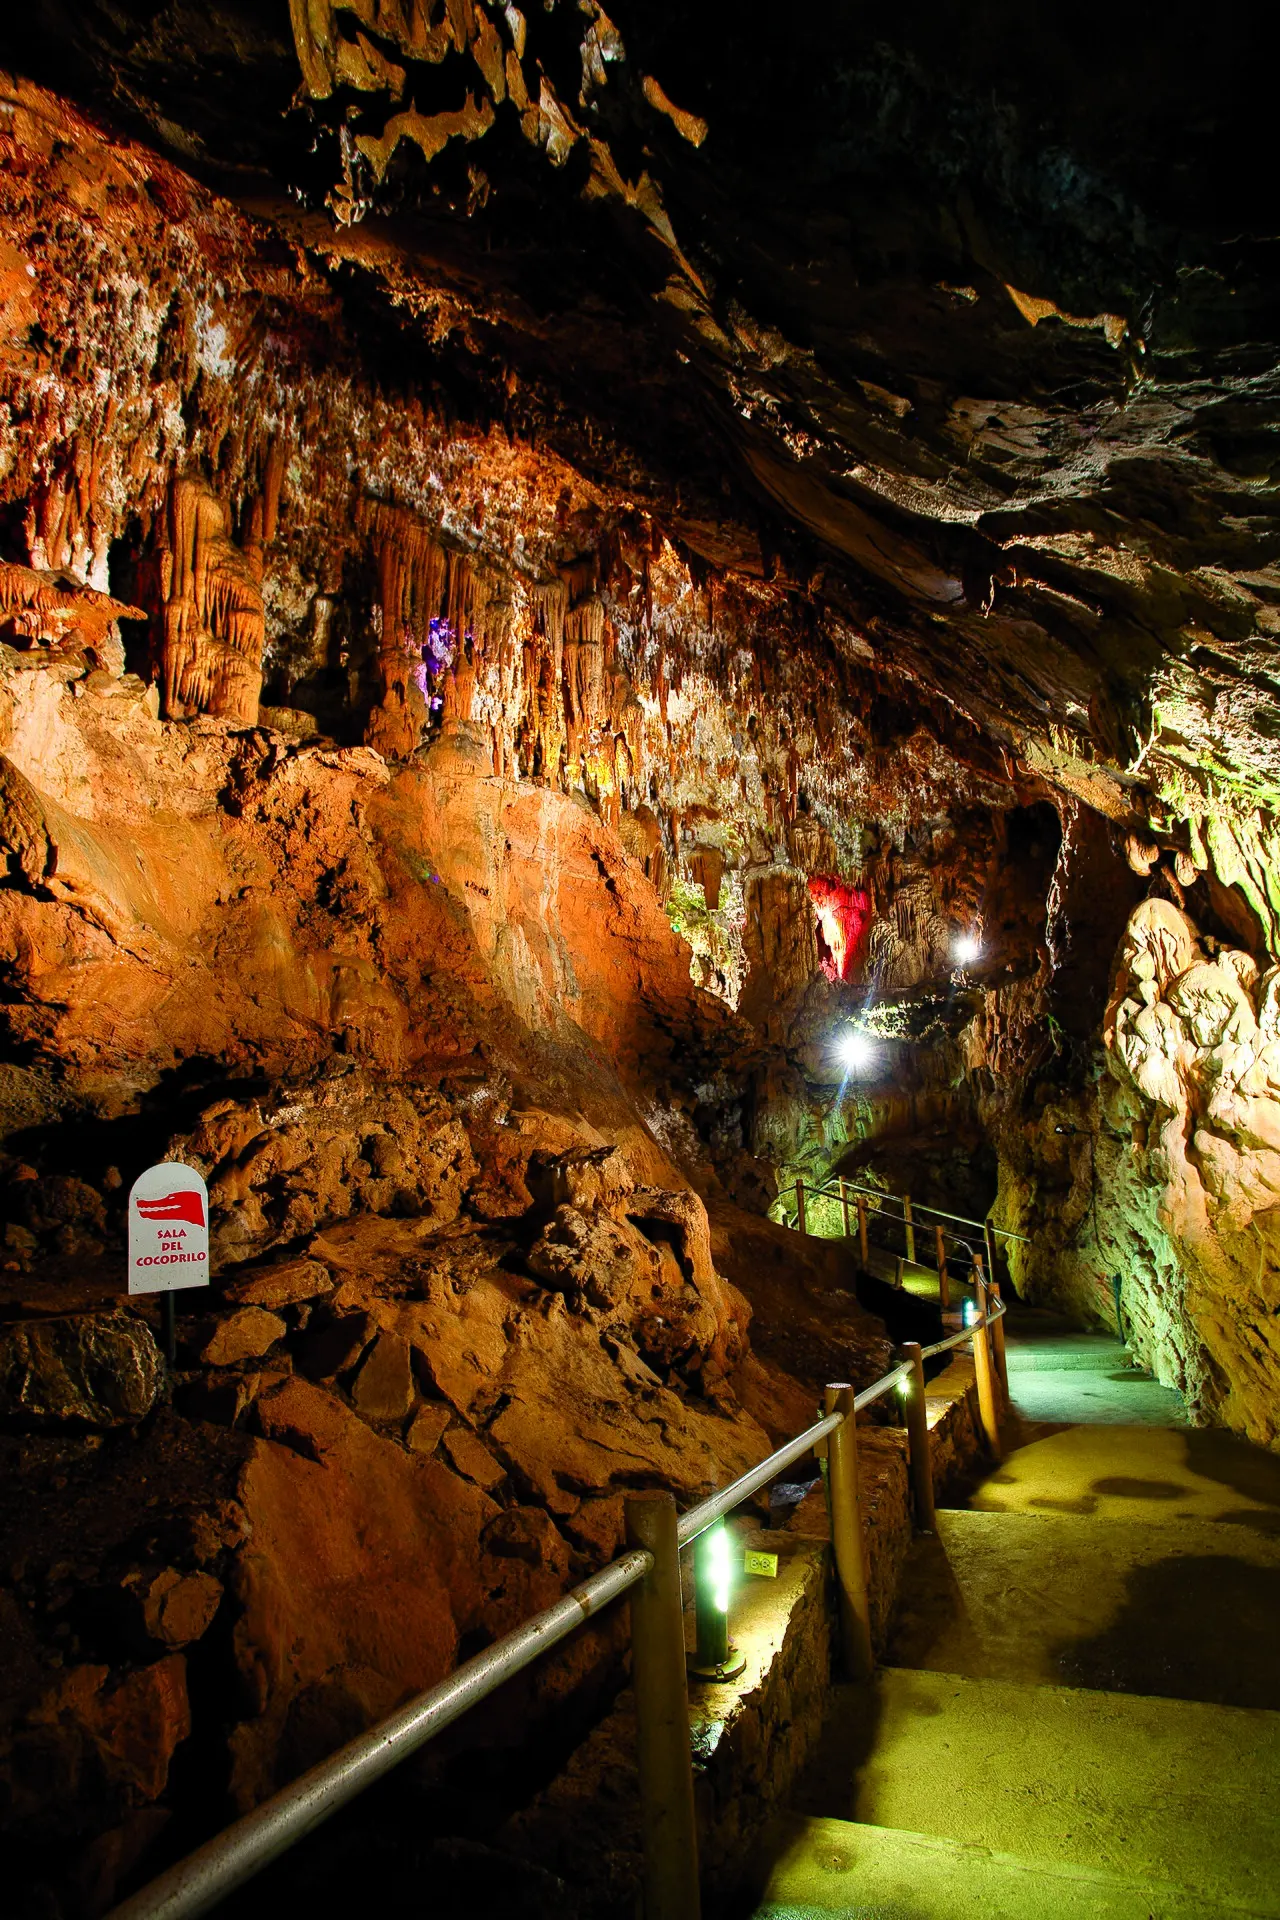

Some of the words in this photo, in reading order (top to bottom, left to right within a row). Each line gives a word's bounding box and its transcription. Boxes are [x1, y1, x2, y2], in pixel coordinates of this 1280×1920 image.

[157, 1229, 187, 1239] SALA
[161, 1241, 183, 1252] DEL
[136, 1251, 207, 1267] COCODRILO
